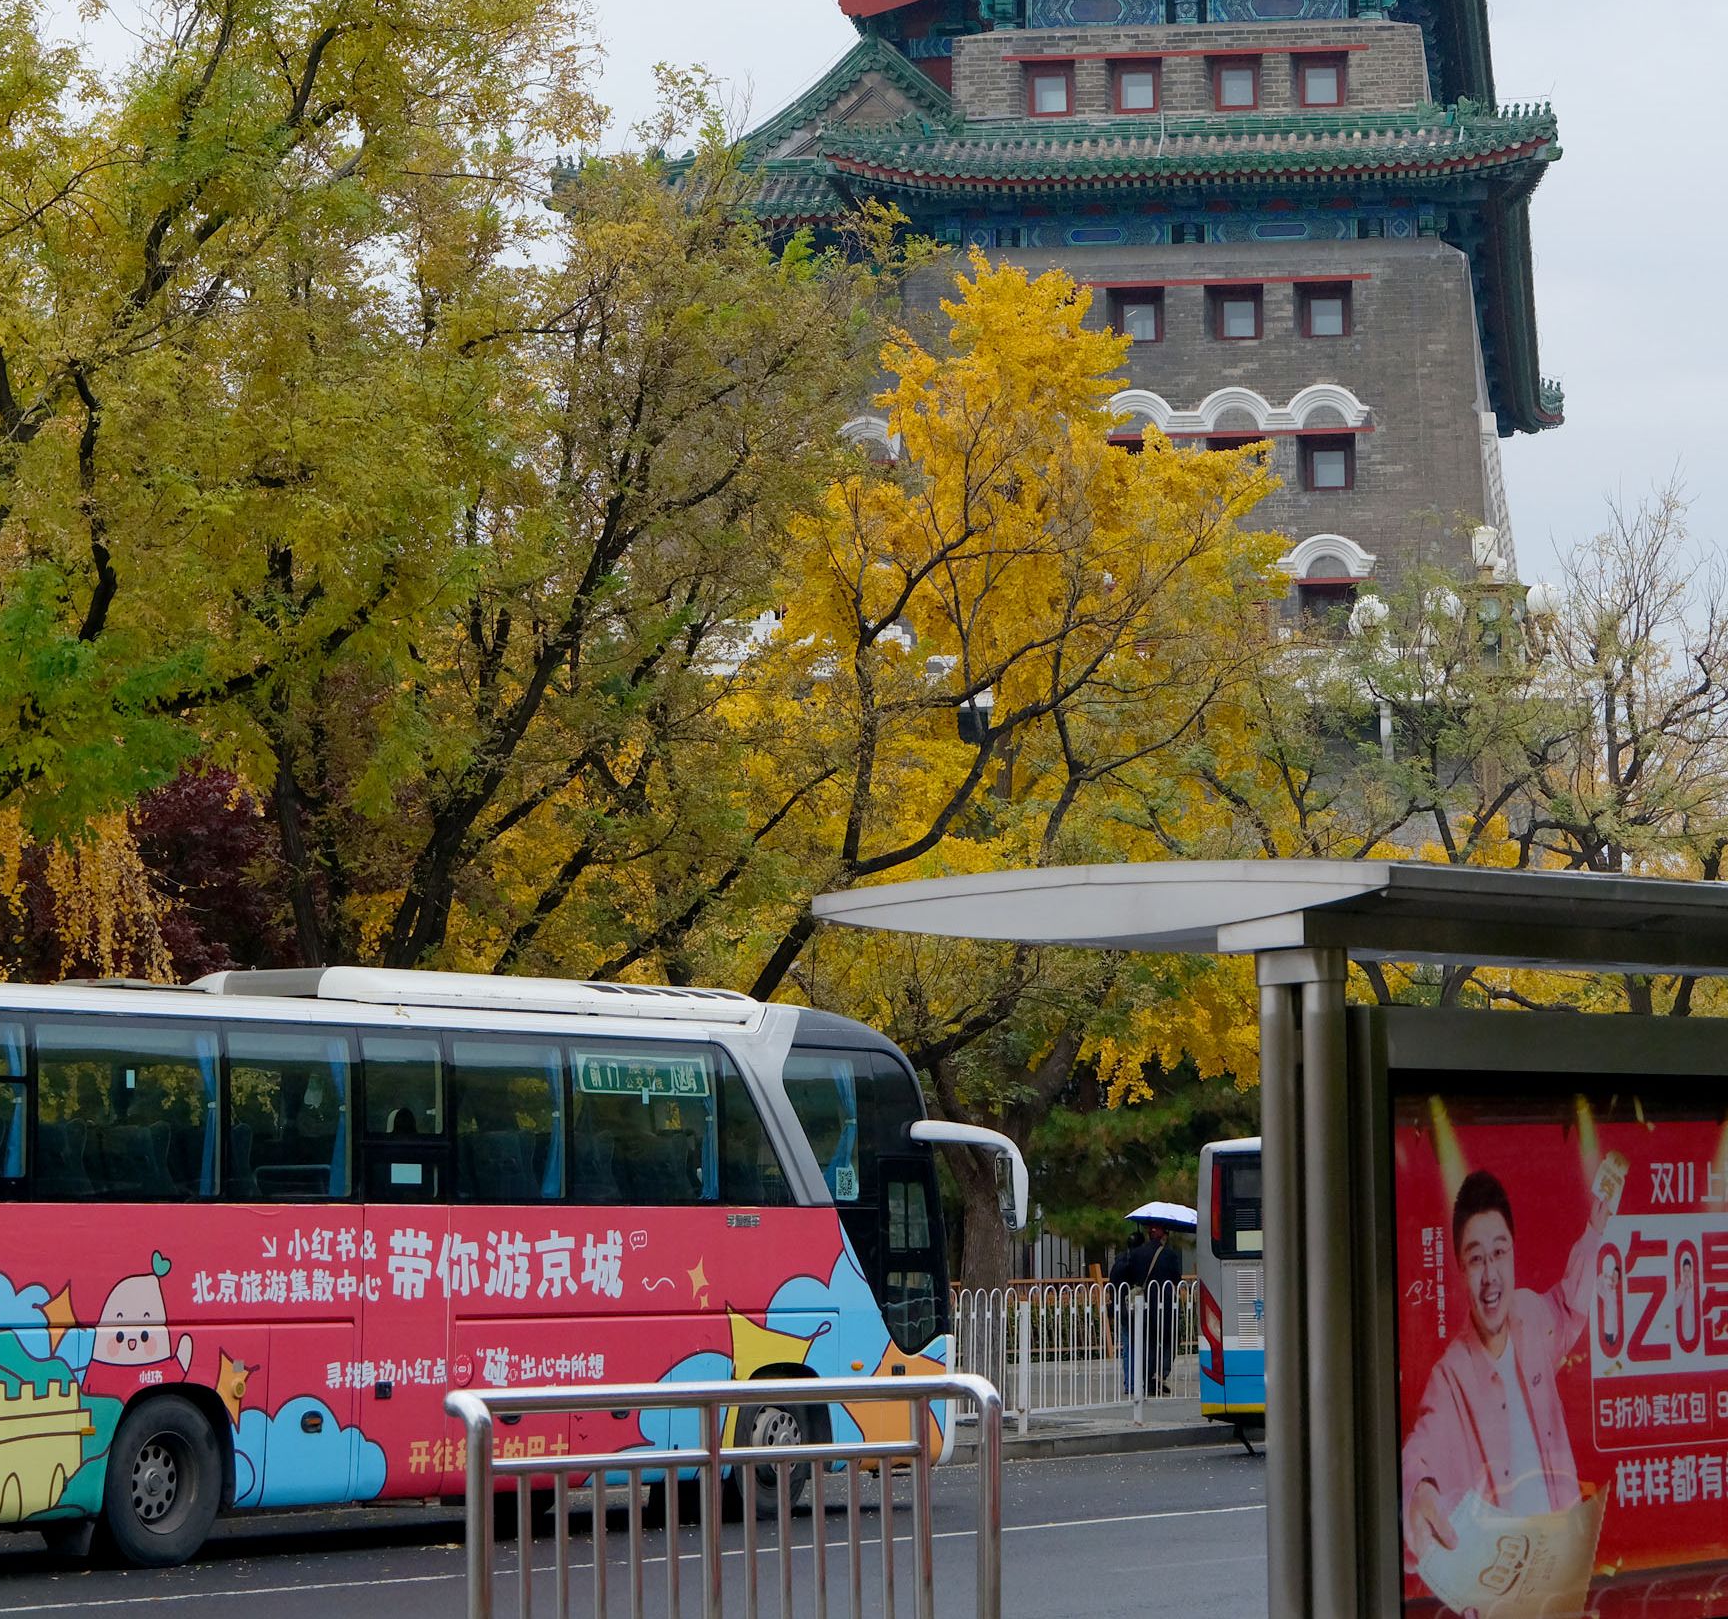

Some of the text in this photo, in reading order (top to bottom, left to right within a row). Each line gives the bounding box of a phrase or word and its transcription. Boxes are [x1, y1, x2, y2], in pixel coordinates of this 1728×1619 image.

[389, 1229, 624, 1300] 带你游京城
[192, 1269, 382, 1304] 北京旅游集散中心
[1599, 1391, 1708, 1430] 5折外卖红包
